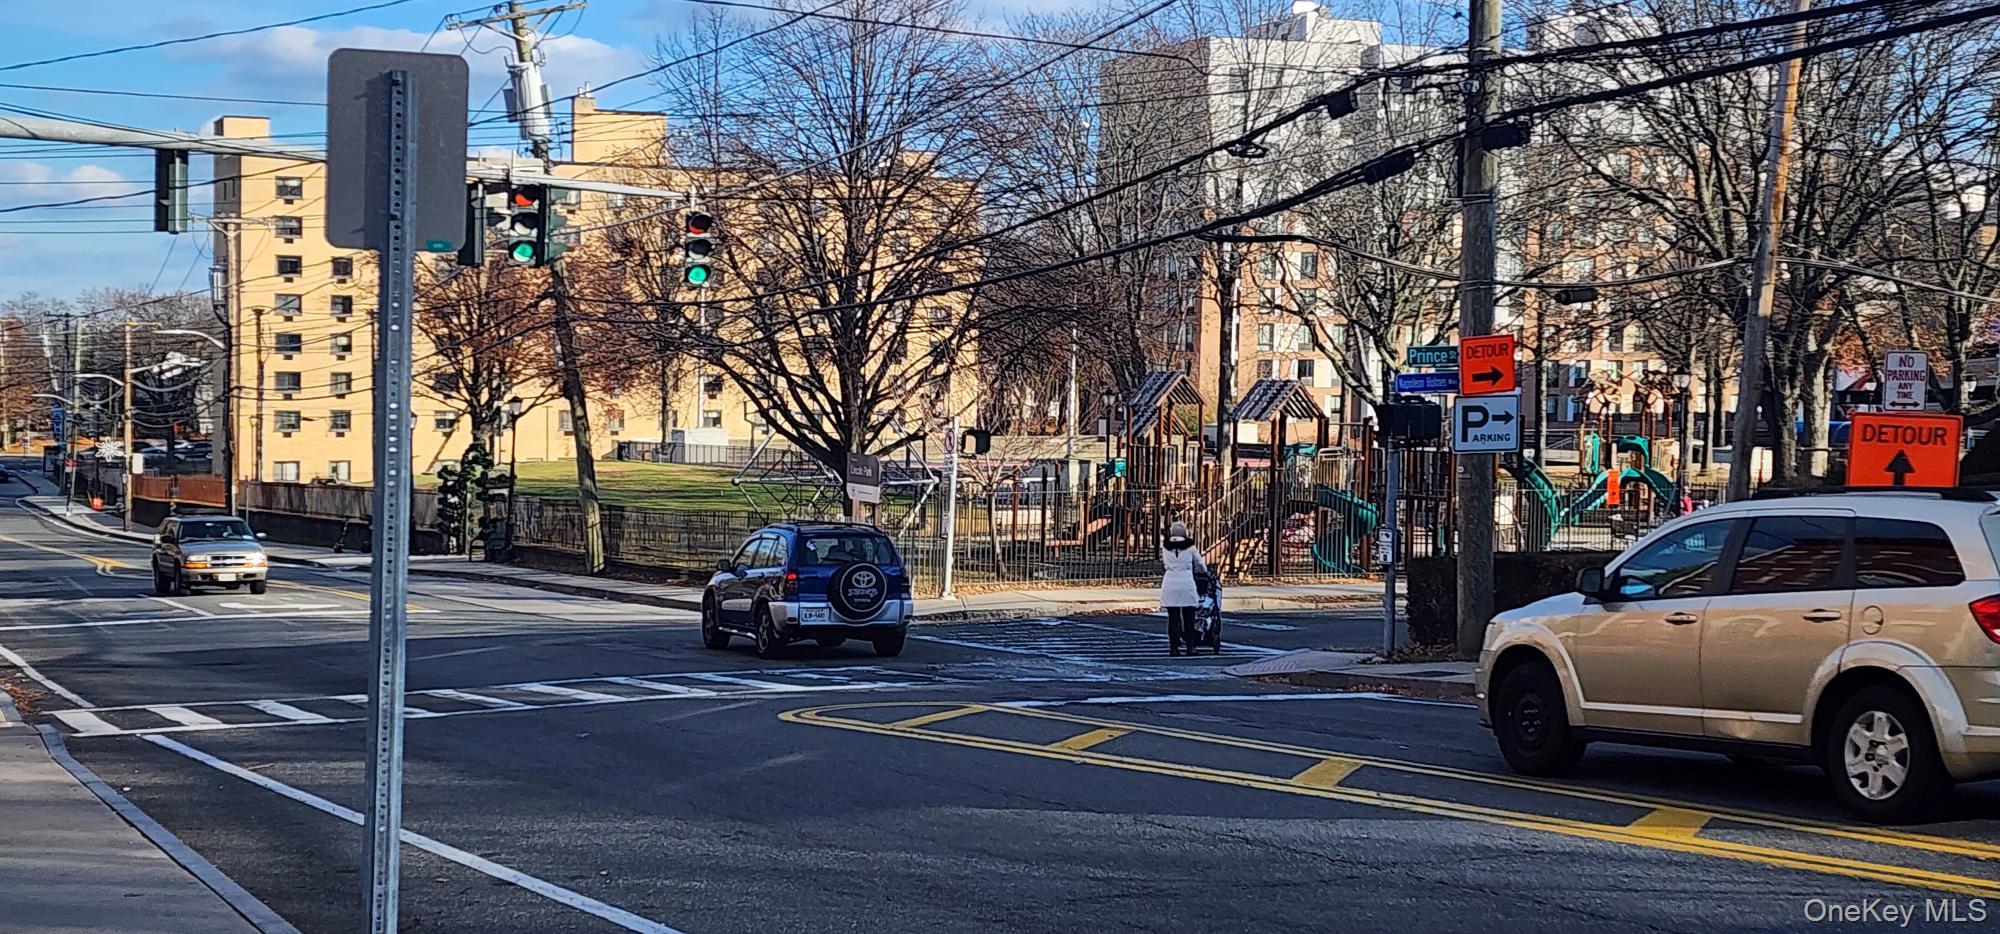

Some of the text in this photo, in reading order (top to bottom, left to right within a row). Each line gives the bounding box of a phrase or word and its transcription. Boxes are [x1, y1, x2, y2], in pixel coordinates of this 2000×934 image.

[1409, 349, 1448, 363] Prince
[1466, 343, 1509, 360] DETOUR
[1899, 356, 1915, 368] NO
[1888, 370, 1926, 381] PARKING
[1896, 391, 1914, 399] TIME
[1862, 423, 1948, 446] DETOUR
